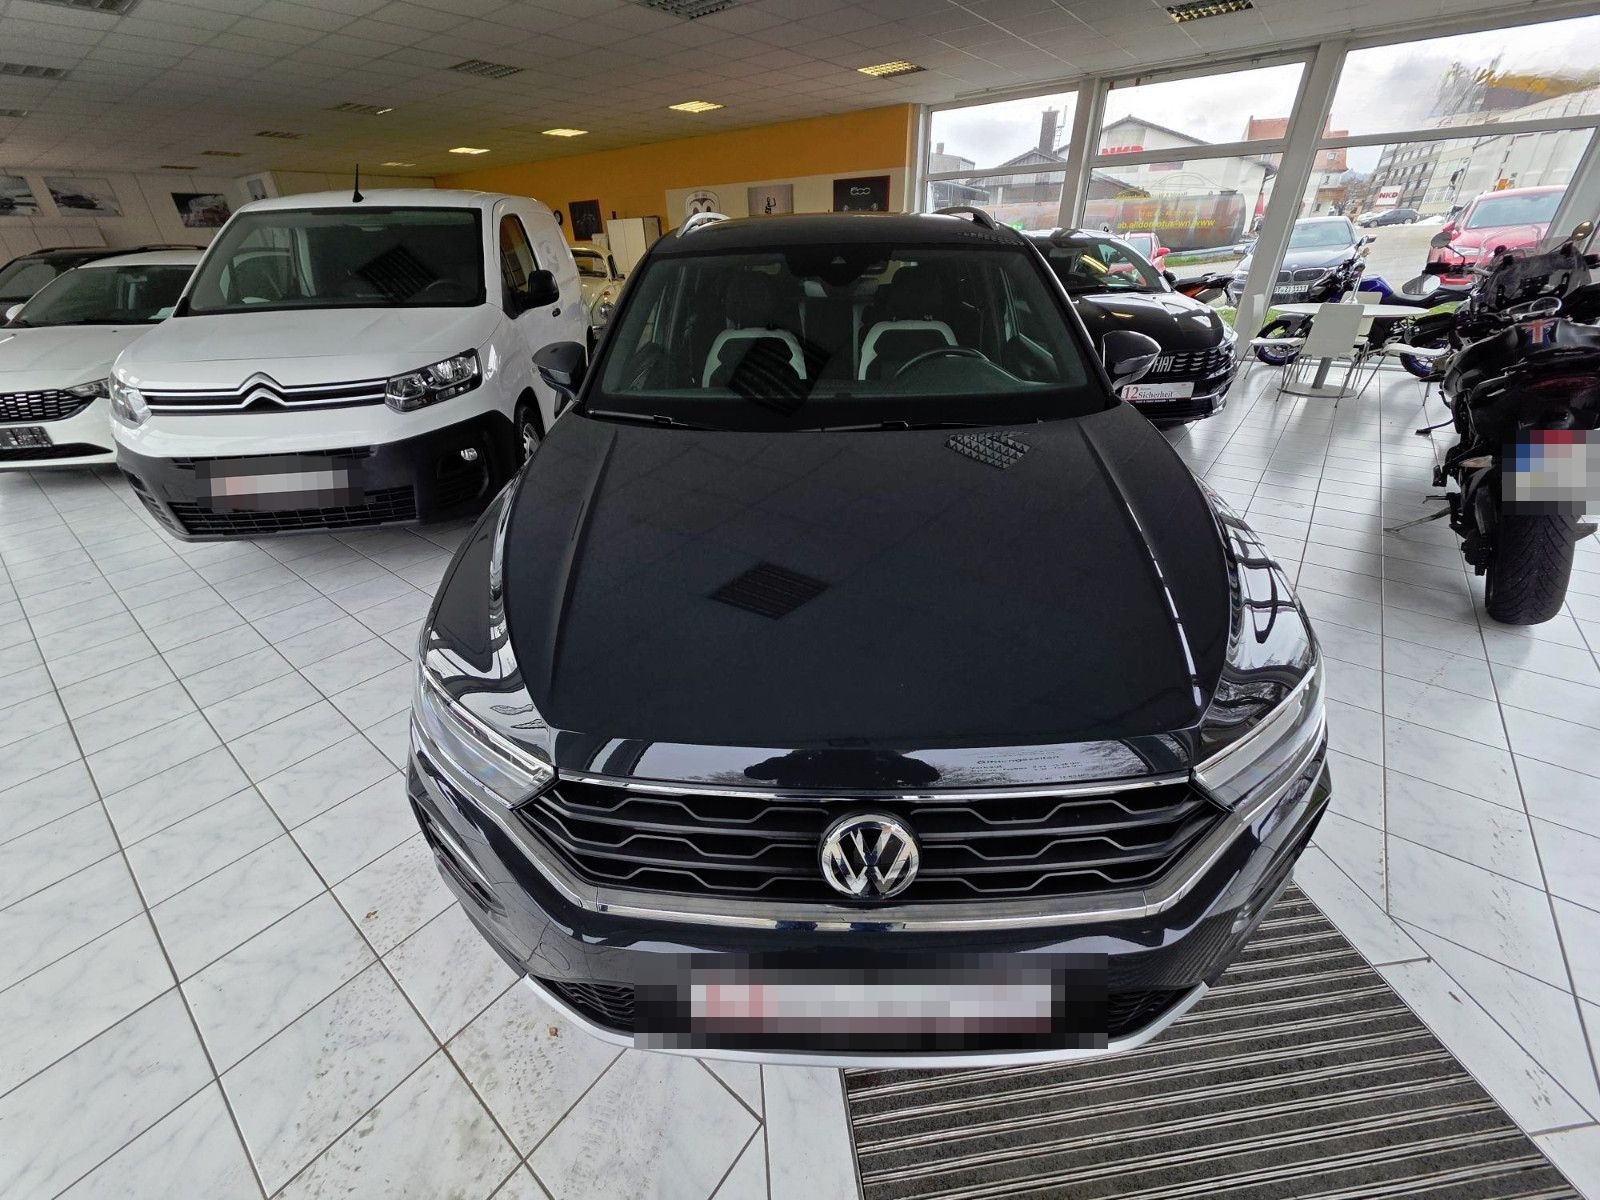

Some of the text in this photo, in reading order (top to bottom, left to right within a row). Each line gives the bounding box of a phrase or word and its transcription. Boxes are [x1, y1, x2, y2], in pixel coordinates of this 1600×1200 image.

[1379, 191, 1399, 199] NKD
[1151, 356, 1176, 373] FIAT
[1123, 386, 1173, 399] 12 Sicherheit
